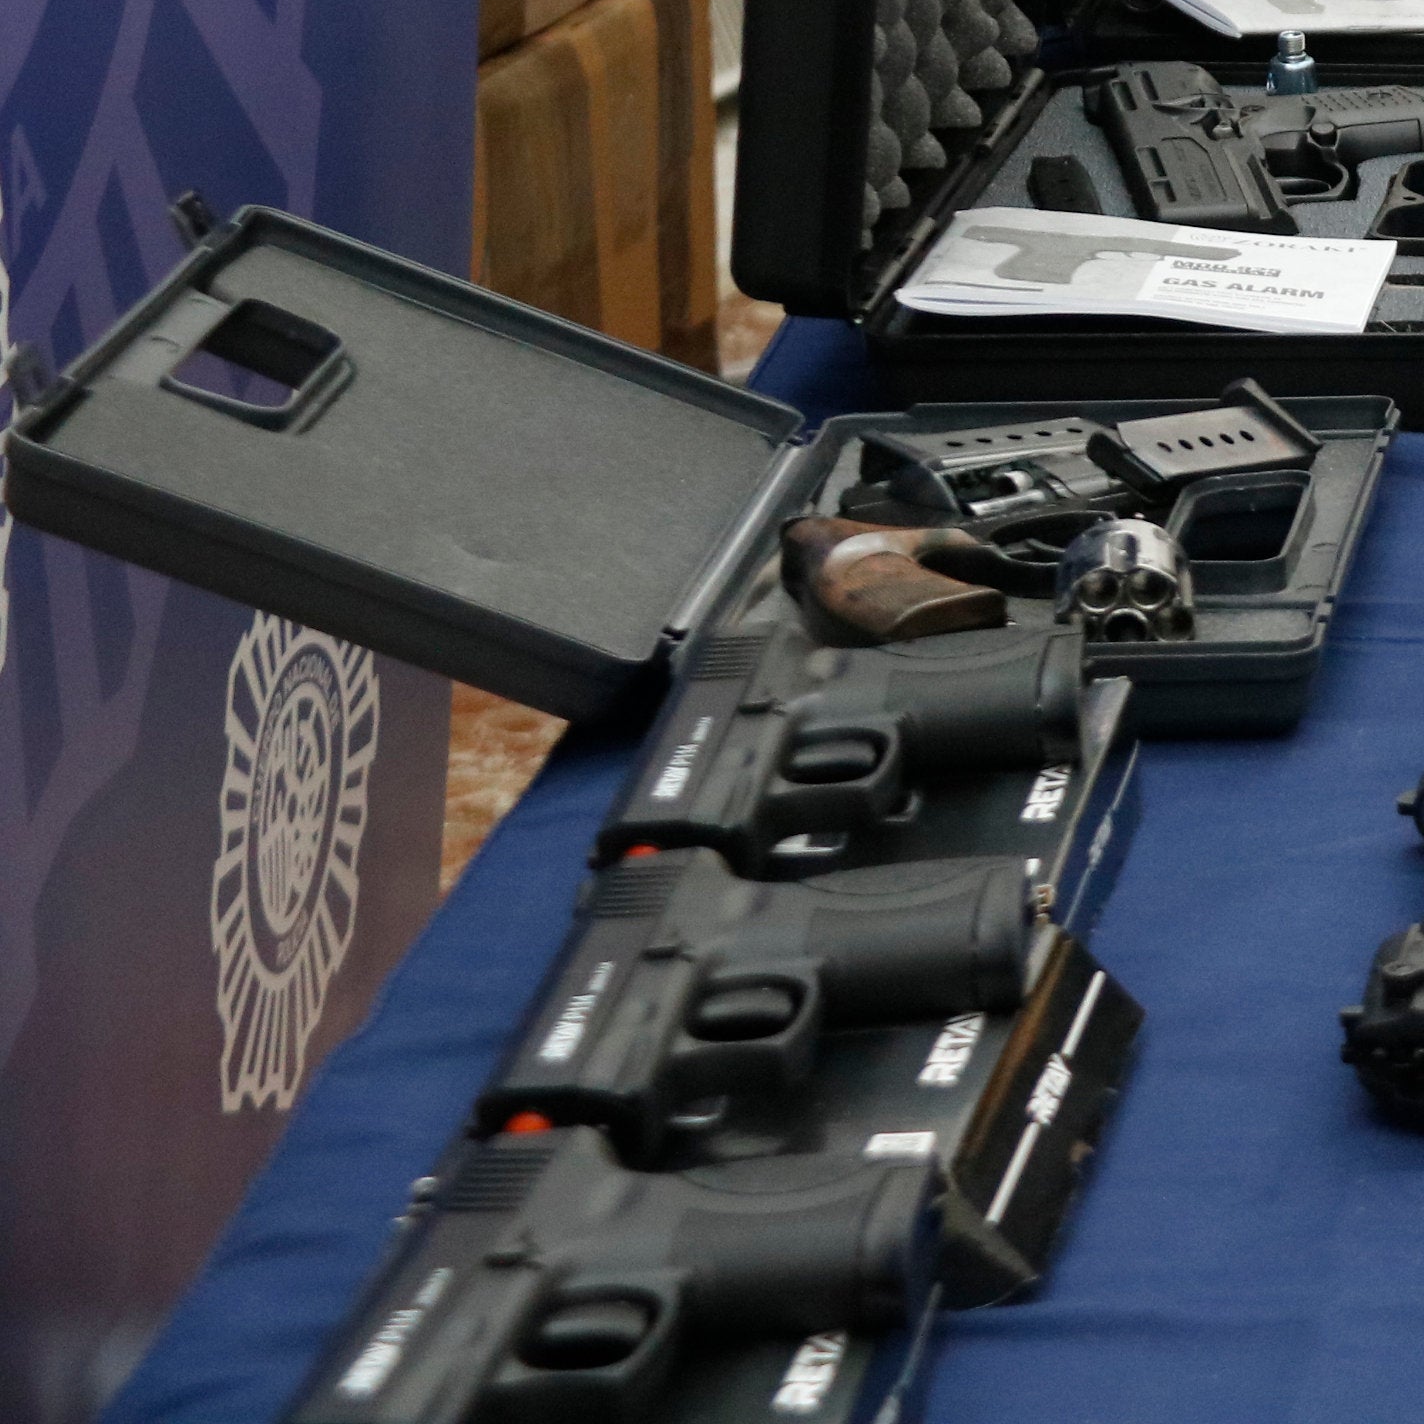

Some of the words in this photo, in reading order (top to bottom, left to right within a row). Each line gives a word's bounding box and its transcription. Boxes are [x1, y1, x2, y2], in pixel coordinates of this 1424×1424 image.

[1162, 277, 1219, 289] GAS
[1226, 282, 1325, 300] ALARM
[1020, 762, 1072, 823] RETA
[916, 1011, 985, 1087] RETA
[771, 1330, 848, 1413] RETA
